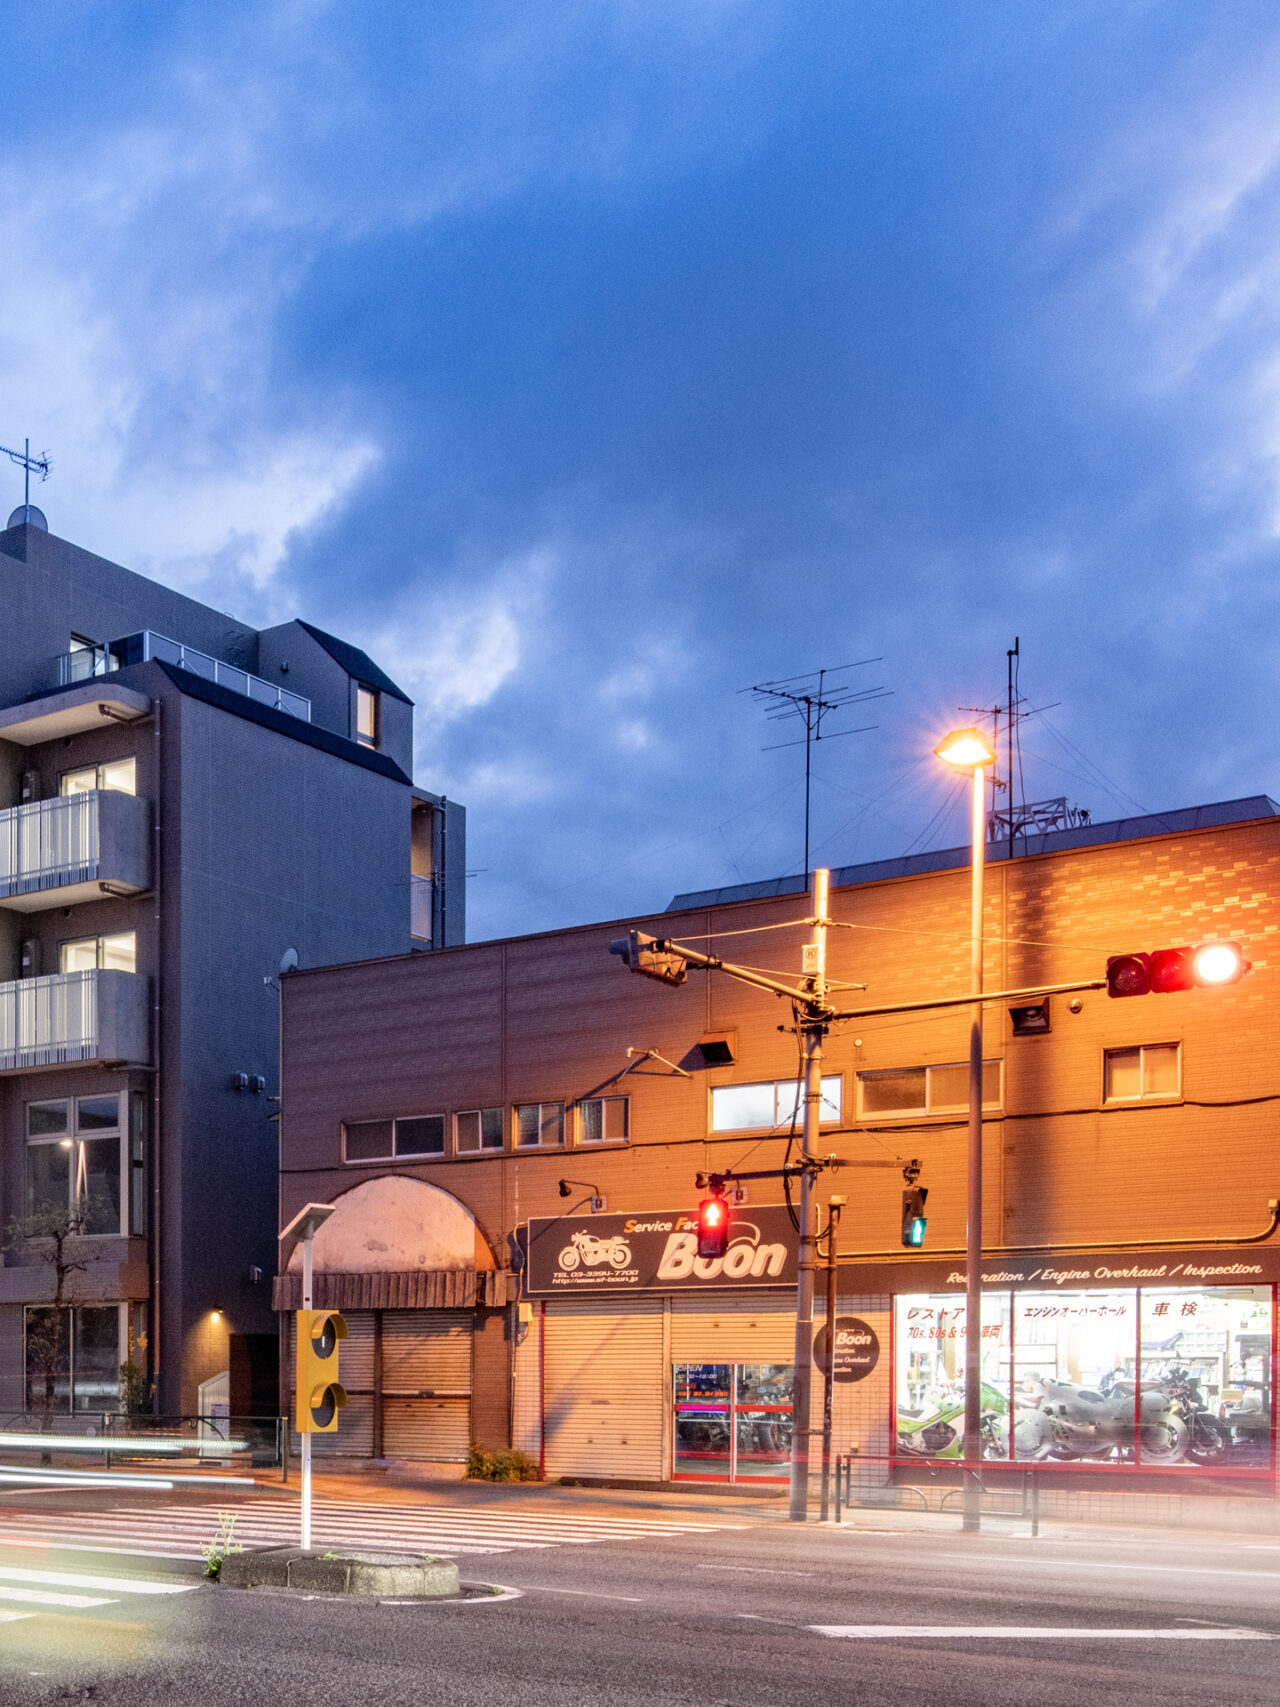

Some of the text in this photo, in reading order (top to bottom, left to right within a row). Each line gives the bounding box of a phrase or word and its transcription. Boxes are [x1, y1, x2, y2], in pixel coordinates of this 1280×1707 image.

[624, 1217, 700, 1233] Service Fac
[657, 1233, 788, 1280] Boon
[571, 1269, 639, 1278] 03-3394-7700
[946, 1272, 1024, 1283] Reration
[1041, 1269, 1090, 1284] Engine
[1094, 1265, 1167, 1278] Overhaul
[1183, 1263, 1263, 1277] Inspection
[907, 1308, 966, 1320] レストア
[1152, 1302, 1198, 1317] 車検
[836, 1332, 872, 1345] Boon
